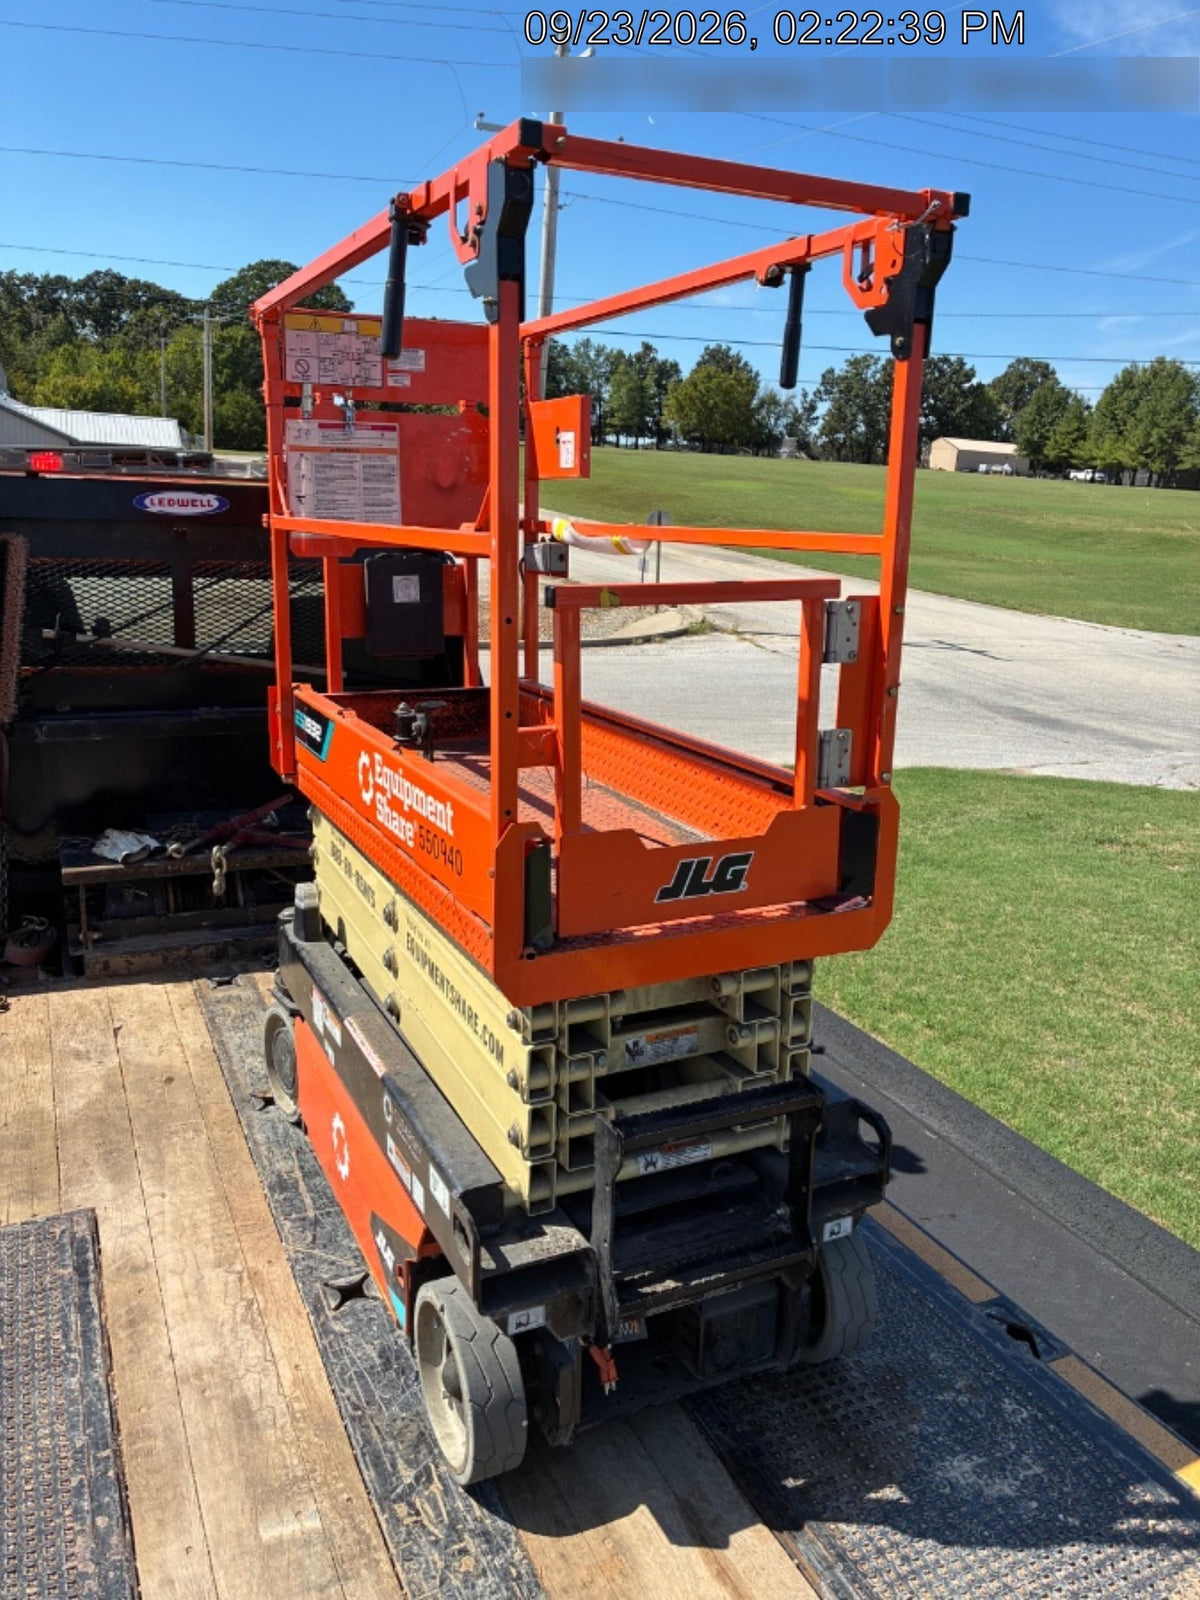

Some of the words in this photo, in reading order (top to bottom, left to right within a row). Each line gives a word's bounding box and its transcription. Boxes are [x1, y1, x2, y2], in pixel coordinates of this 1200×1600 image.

[149, 497, 214, 508] LEDWELL
[373, 751, 455, 837] Equipment
[375, 791, 415, 849] Share
[418, 824, 463, 877] 550940
[654, 850, 756, 904] JLG
[406, 931, 504, 1067] EQUIPMENTSHARE.COM
